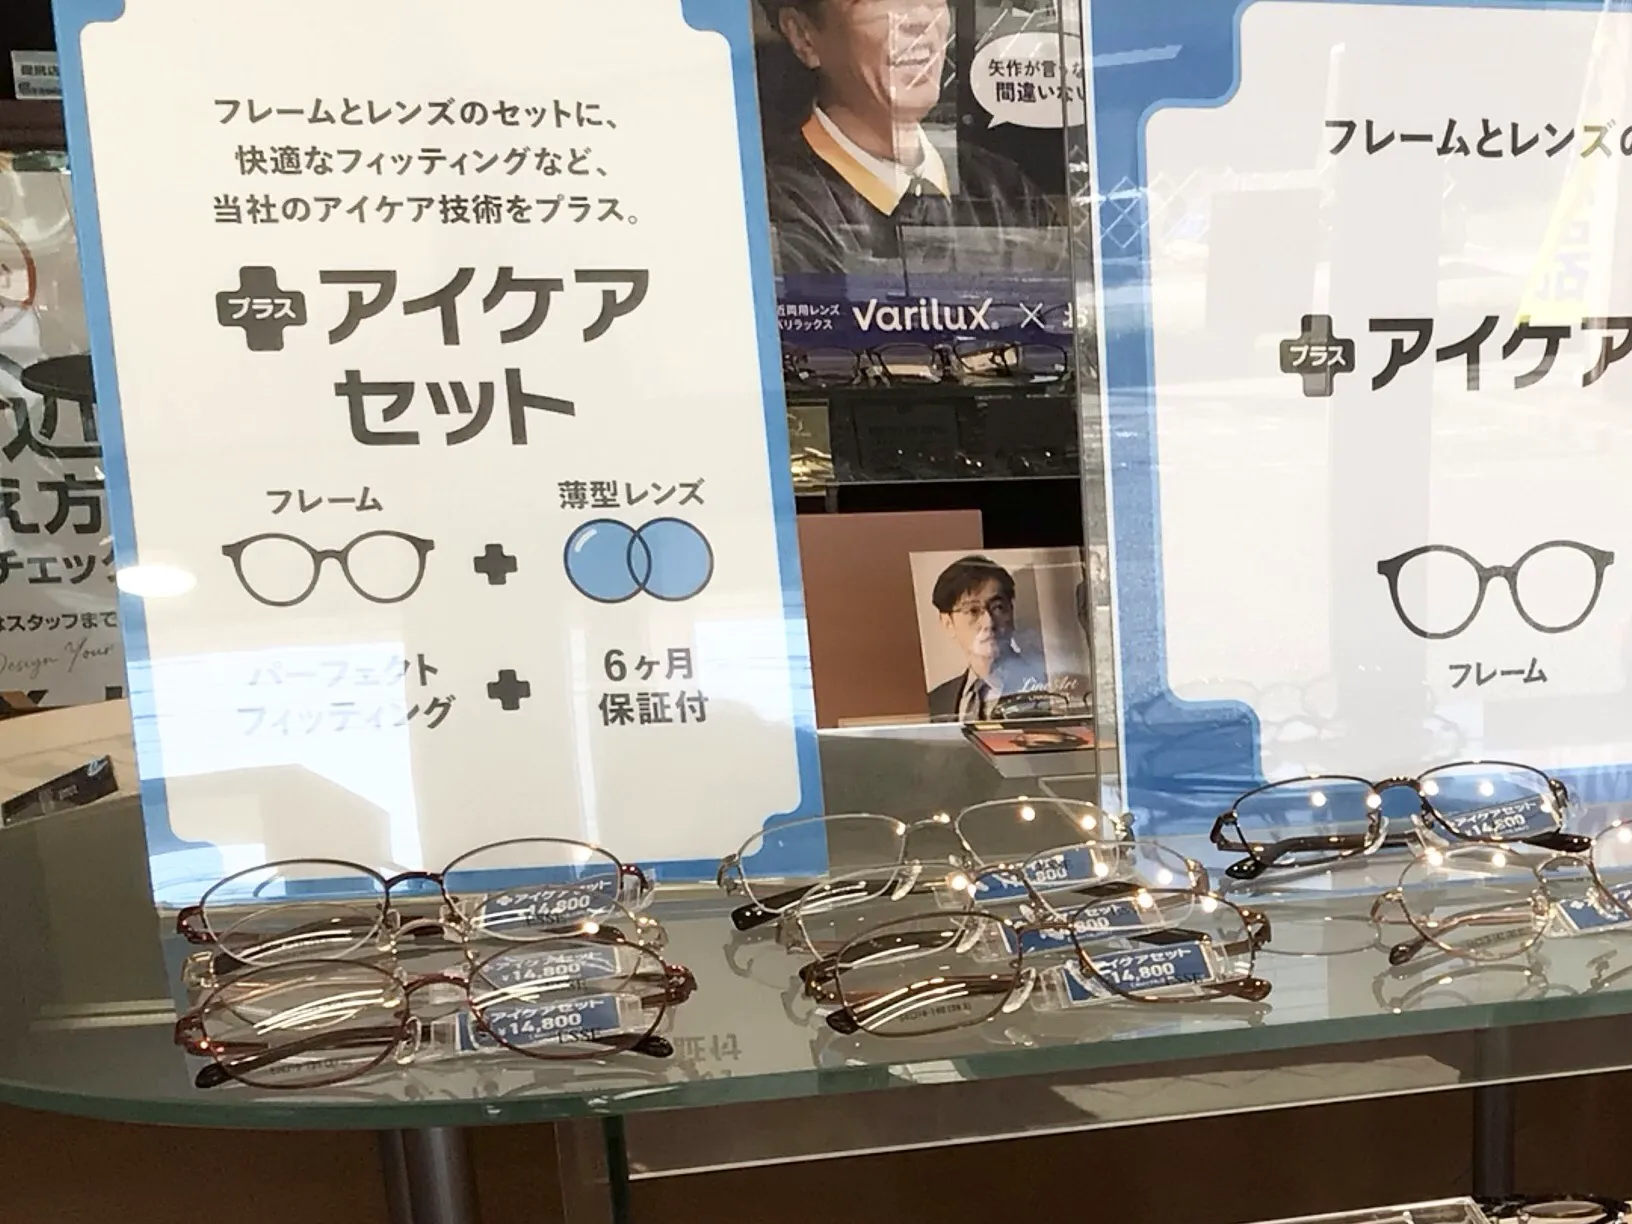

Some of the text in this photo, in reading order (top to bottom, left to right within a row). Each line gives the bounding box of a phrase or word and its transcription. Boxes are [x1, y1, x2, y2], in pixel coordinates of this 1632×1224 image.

[988, 58, 1085, 78] 矢作が言な
[213, 97, 618, 130] フレームとレンズのセットに、
[235, 144, 608, 177] 快適なフィッティングなど、
[213, 192, 639, 225] 当社のアイケア技術をプラス。
[319, 266, 650, 346] アイケア
[333, 367, 576, 447] セット
[265, 485, 384, 516] フレーム
[558, 478, 706, 510] 薄型レンズ
[1448, 657, 1548, 690] フレーム
[599, 690, 709, 727] 保証付
